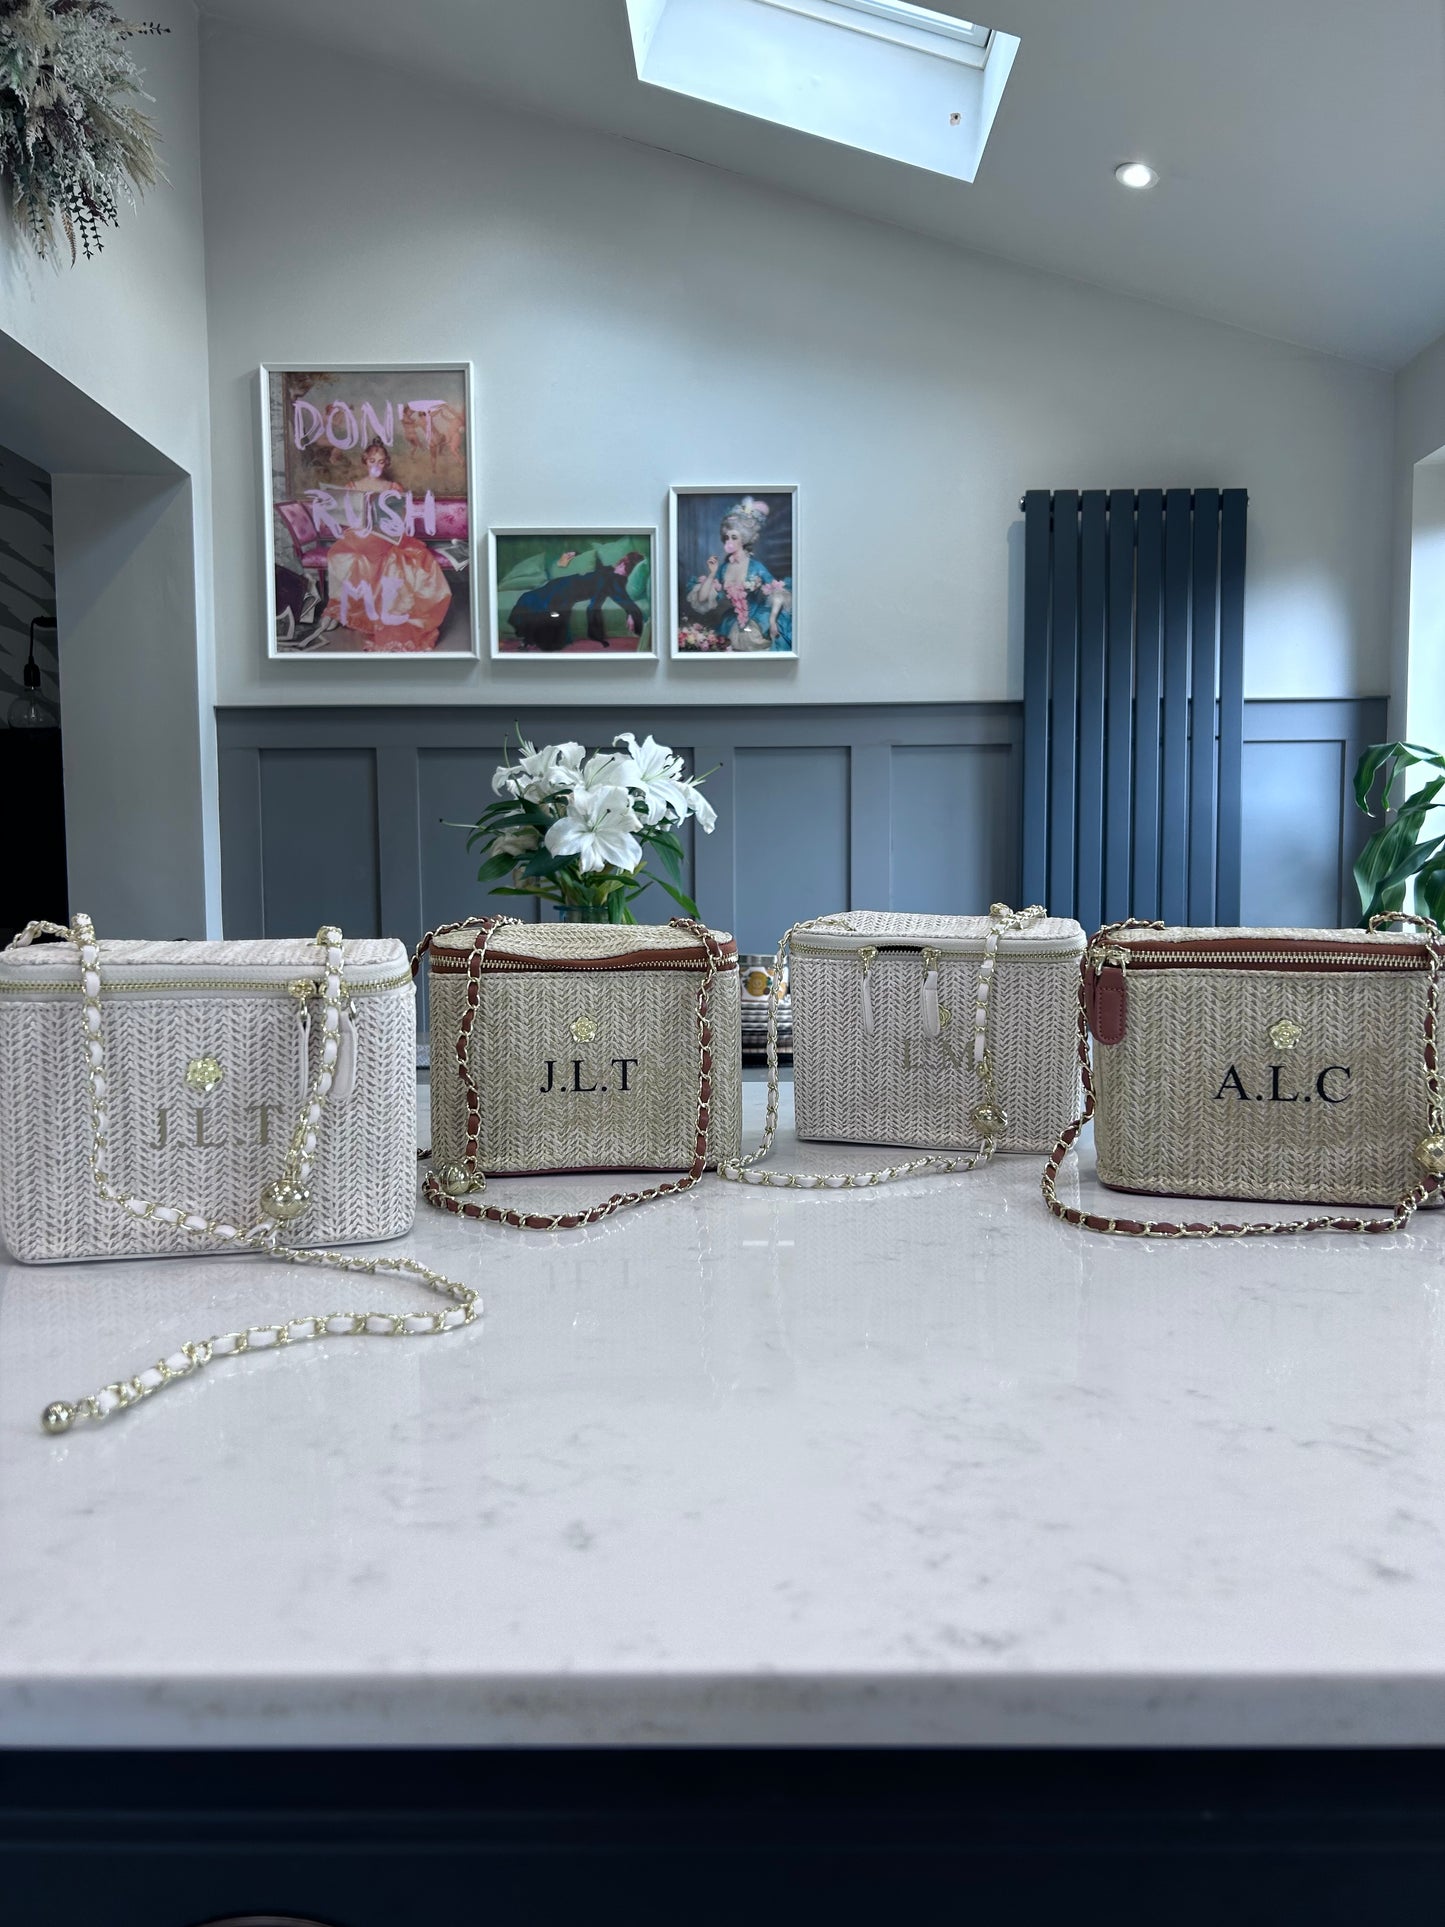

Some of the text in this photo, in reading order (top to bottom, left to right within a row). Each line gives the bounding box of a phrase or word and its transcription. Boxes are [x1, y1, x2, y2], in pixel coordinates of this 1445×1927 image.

[293, 399, 447, 450] DON'T
[304, 489, 436, 539] RUSH
[339, 575, 410, 626] ME
[540, 1058, 639, 1093] J.L.T
[1213, 1064, 1352, 1103] A.L.C
[149, 1104, 283, 1150] J.L.T
